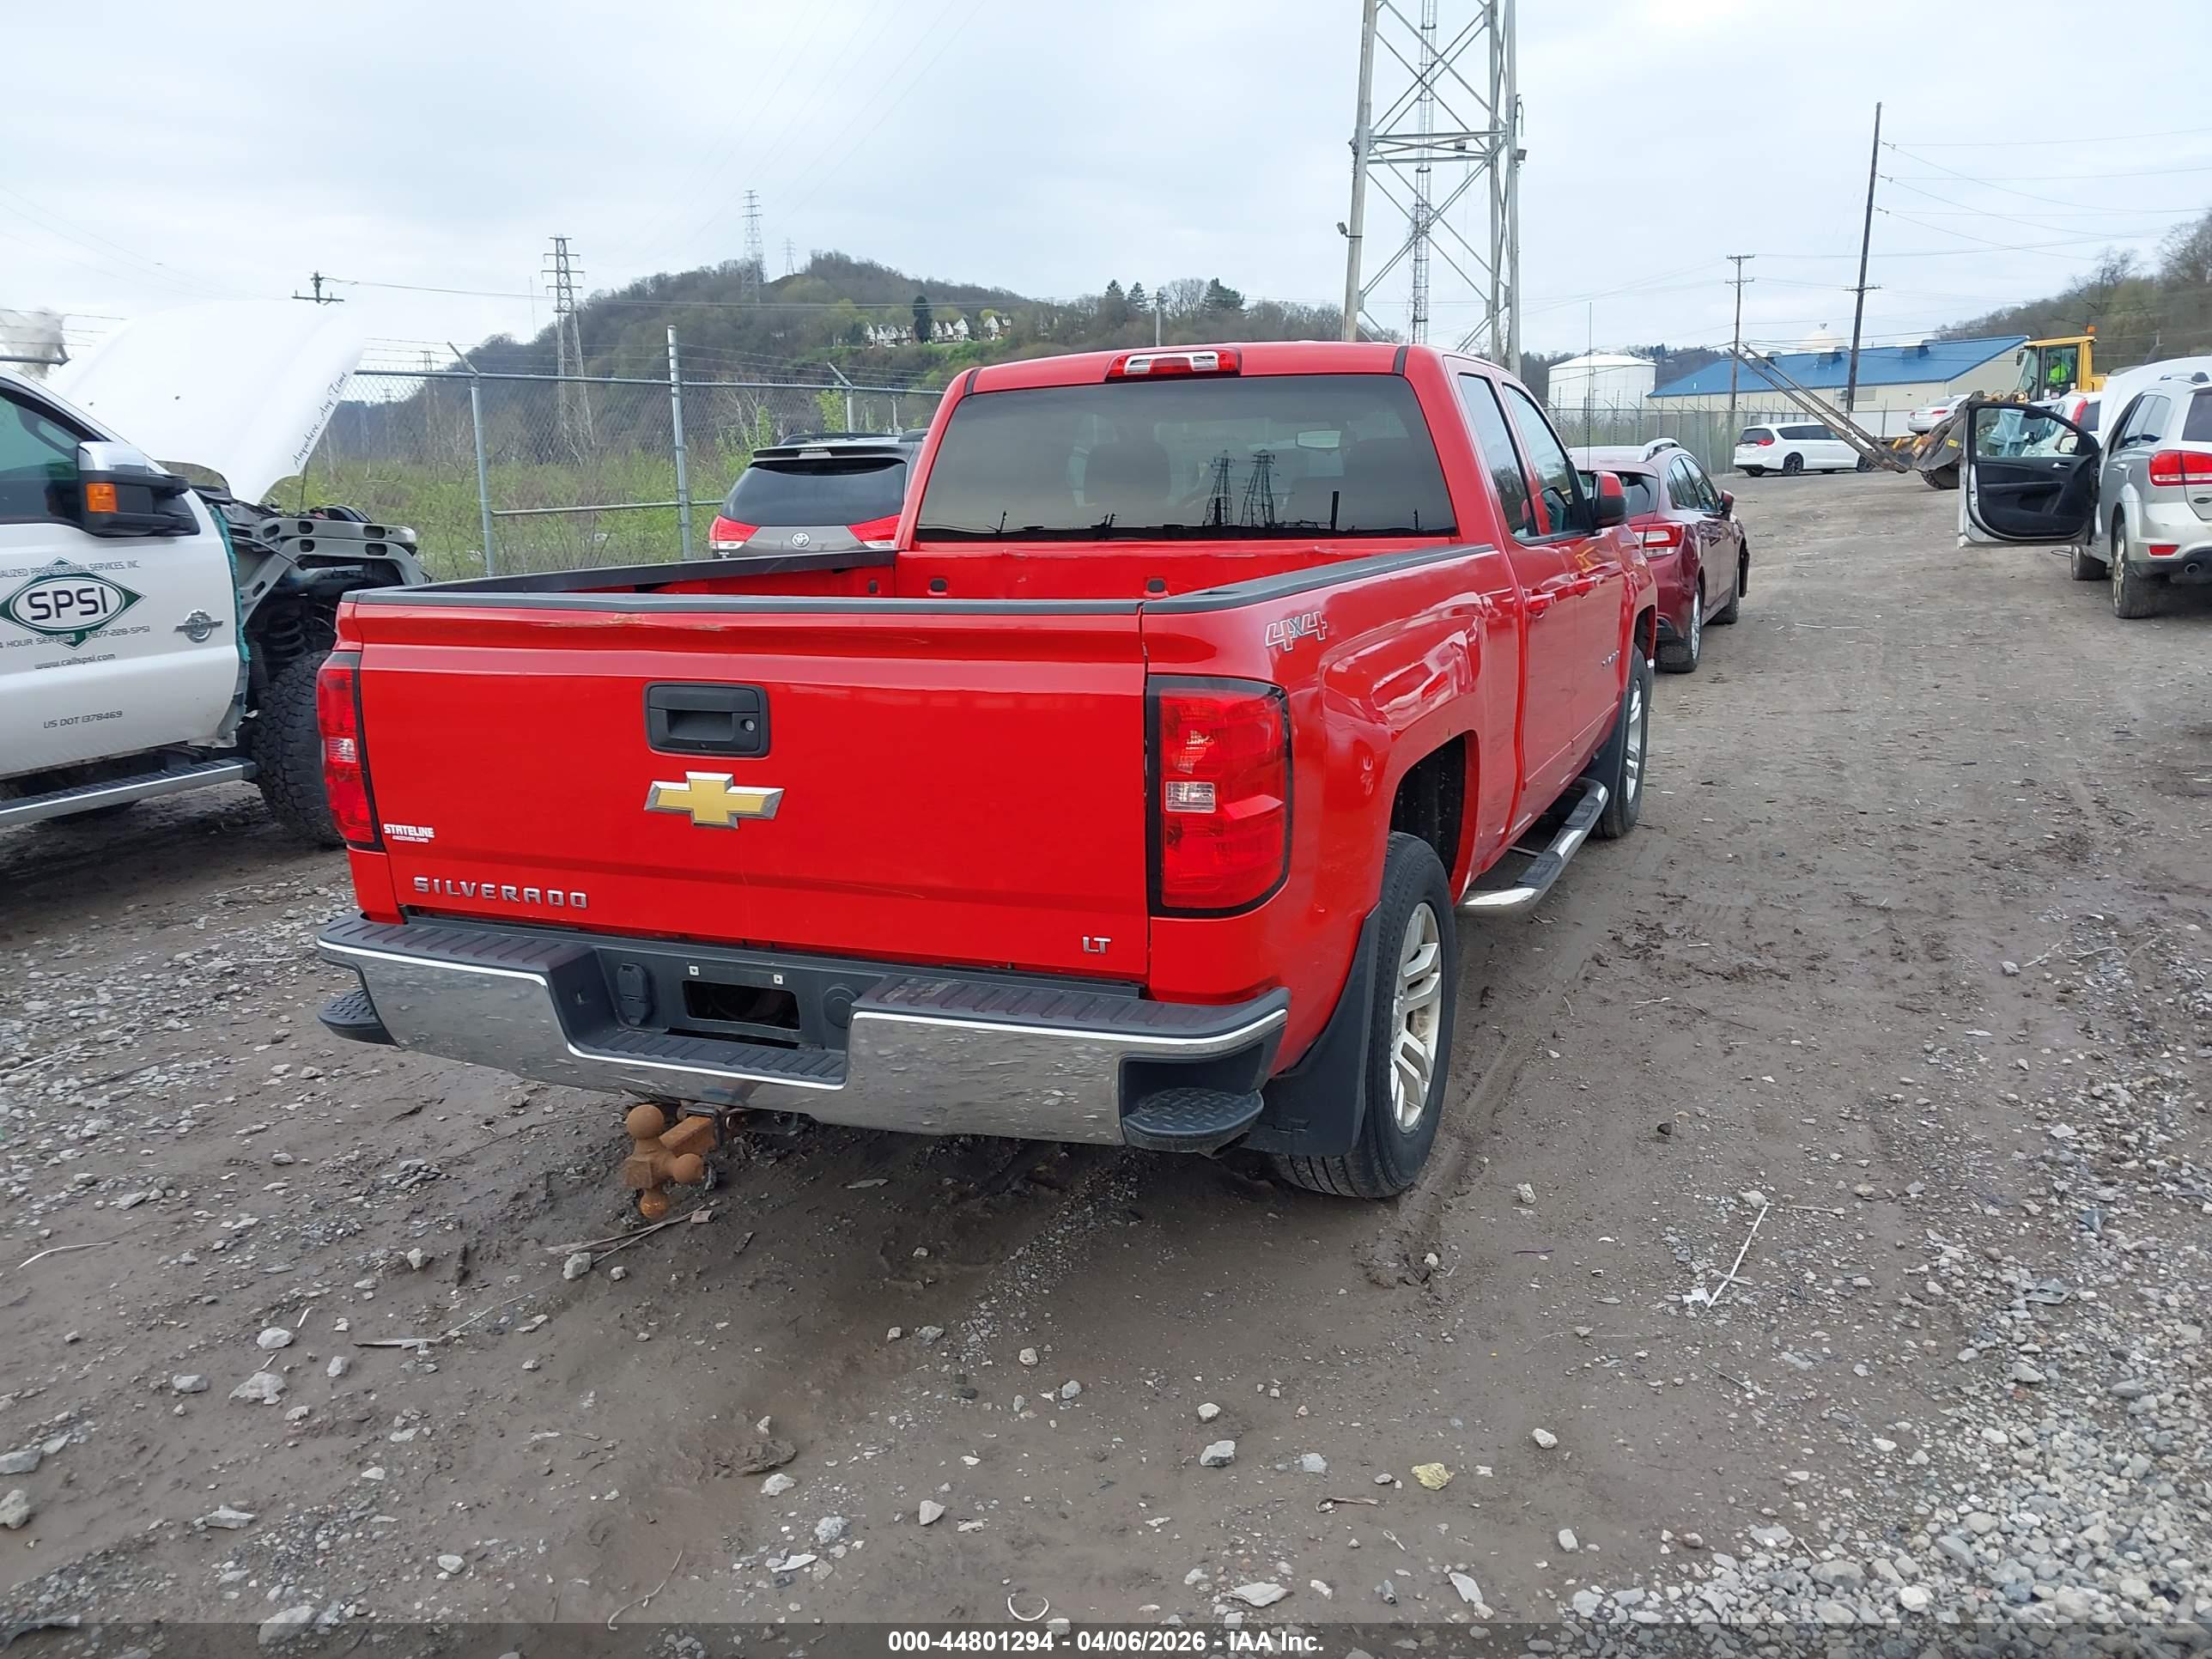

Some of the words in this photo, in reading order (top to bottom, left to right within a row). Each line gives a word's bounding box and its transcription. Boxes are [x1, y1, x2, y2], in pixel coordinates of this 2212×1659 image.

[27, 586, 108, 621] SPSI
[7, 638, 33, 647] HOUR
[34, 653, 116, 670] www.callspsi.com
[44, 720, 58, 729] US
[60, 716, 79, 726] DOT
[383, 823, 434, 838] STATELINE
[413, 877, 587, 908] SILVERADO
[1083, 936, 1111, 954] LT
